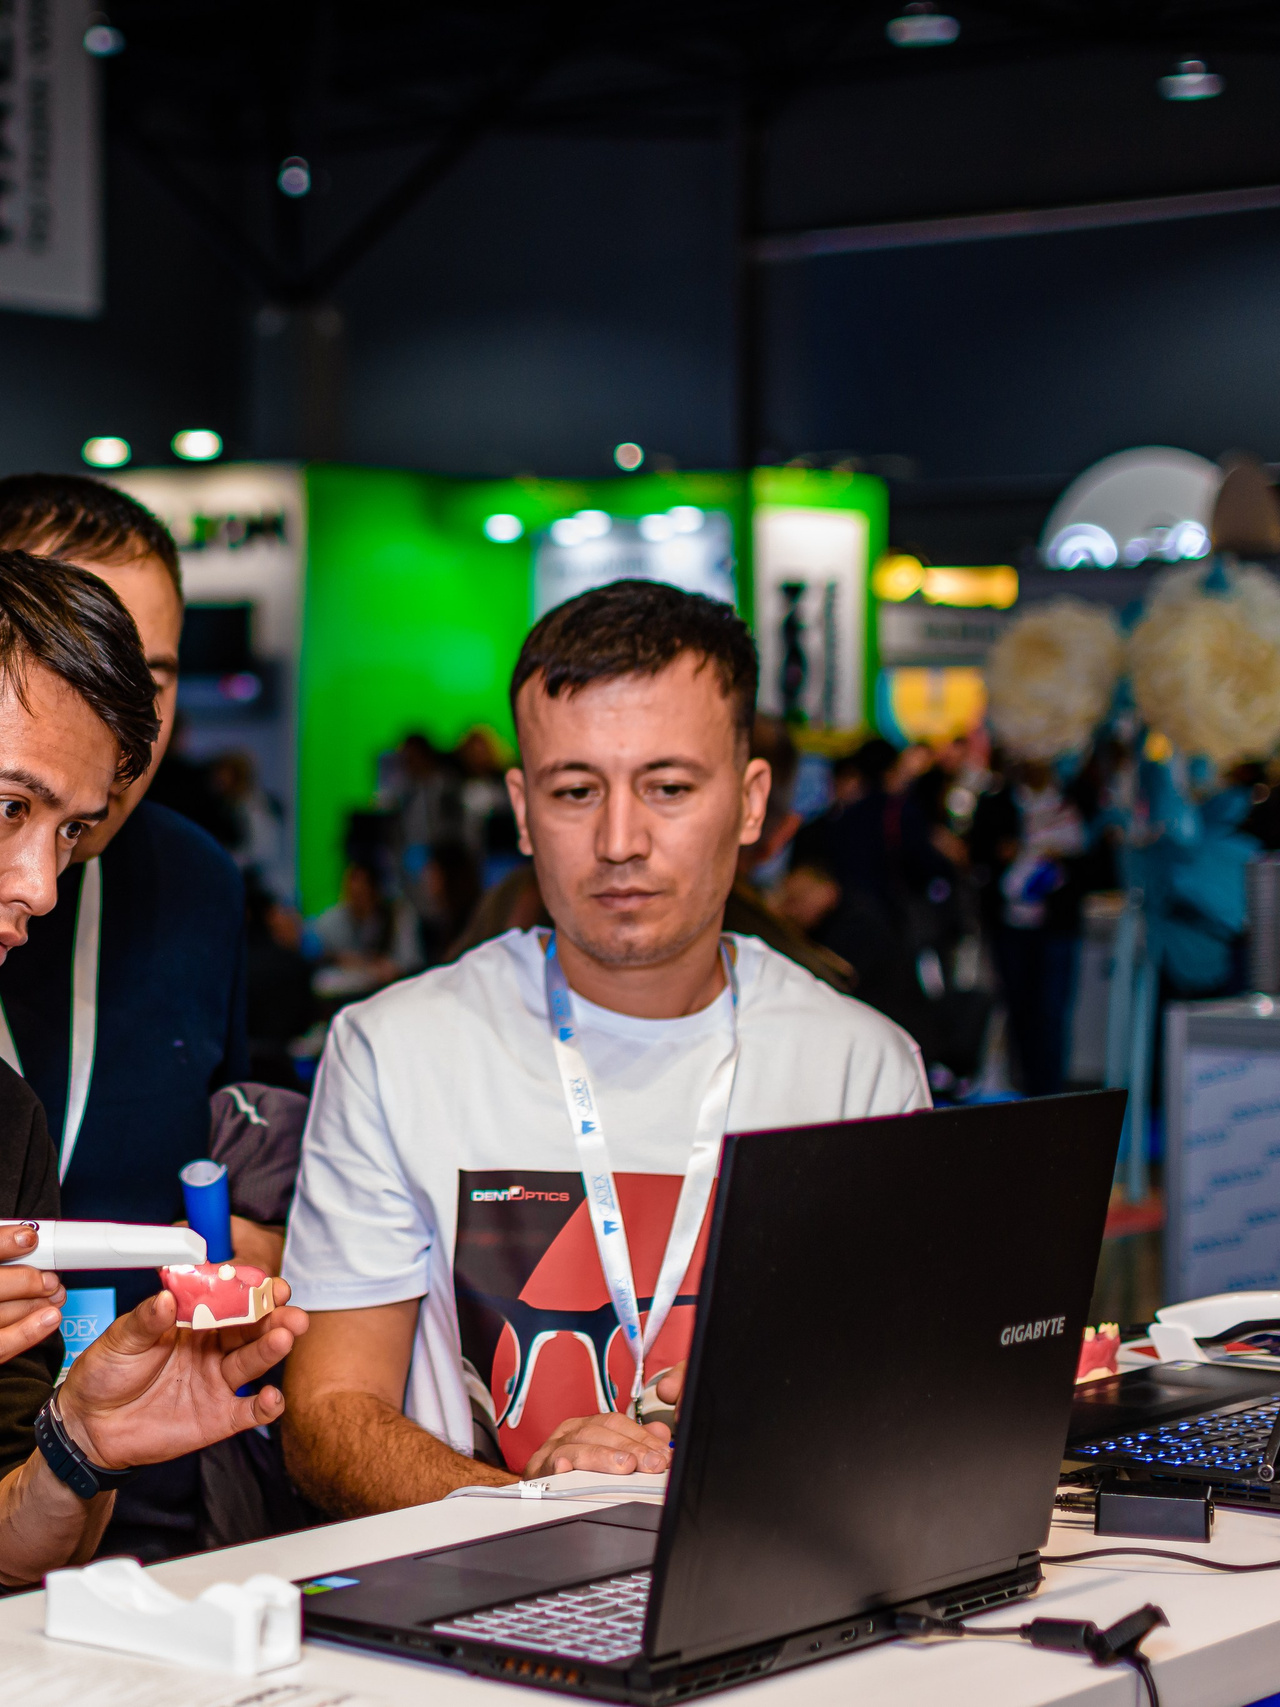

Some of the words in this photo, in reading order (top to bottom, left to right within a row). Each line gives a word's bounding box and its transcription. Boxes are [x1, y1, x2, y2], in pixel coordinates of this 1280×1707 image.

[570, 1077, 589, 1117] CADEX
[471, 1186, 570, 1202] DENTOPTICS
[591, 1174, 611, 1216] CADEX
[60, 1319, 98, 1338] DEX
[1001, 1316, 1066, 1346] GIGABYTE
